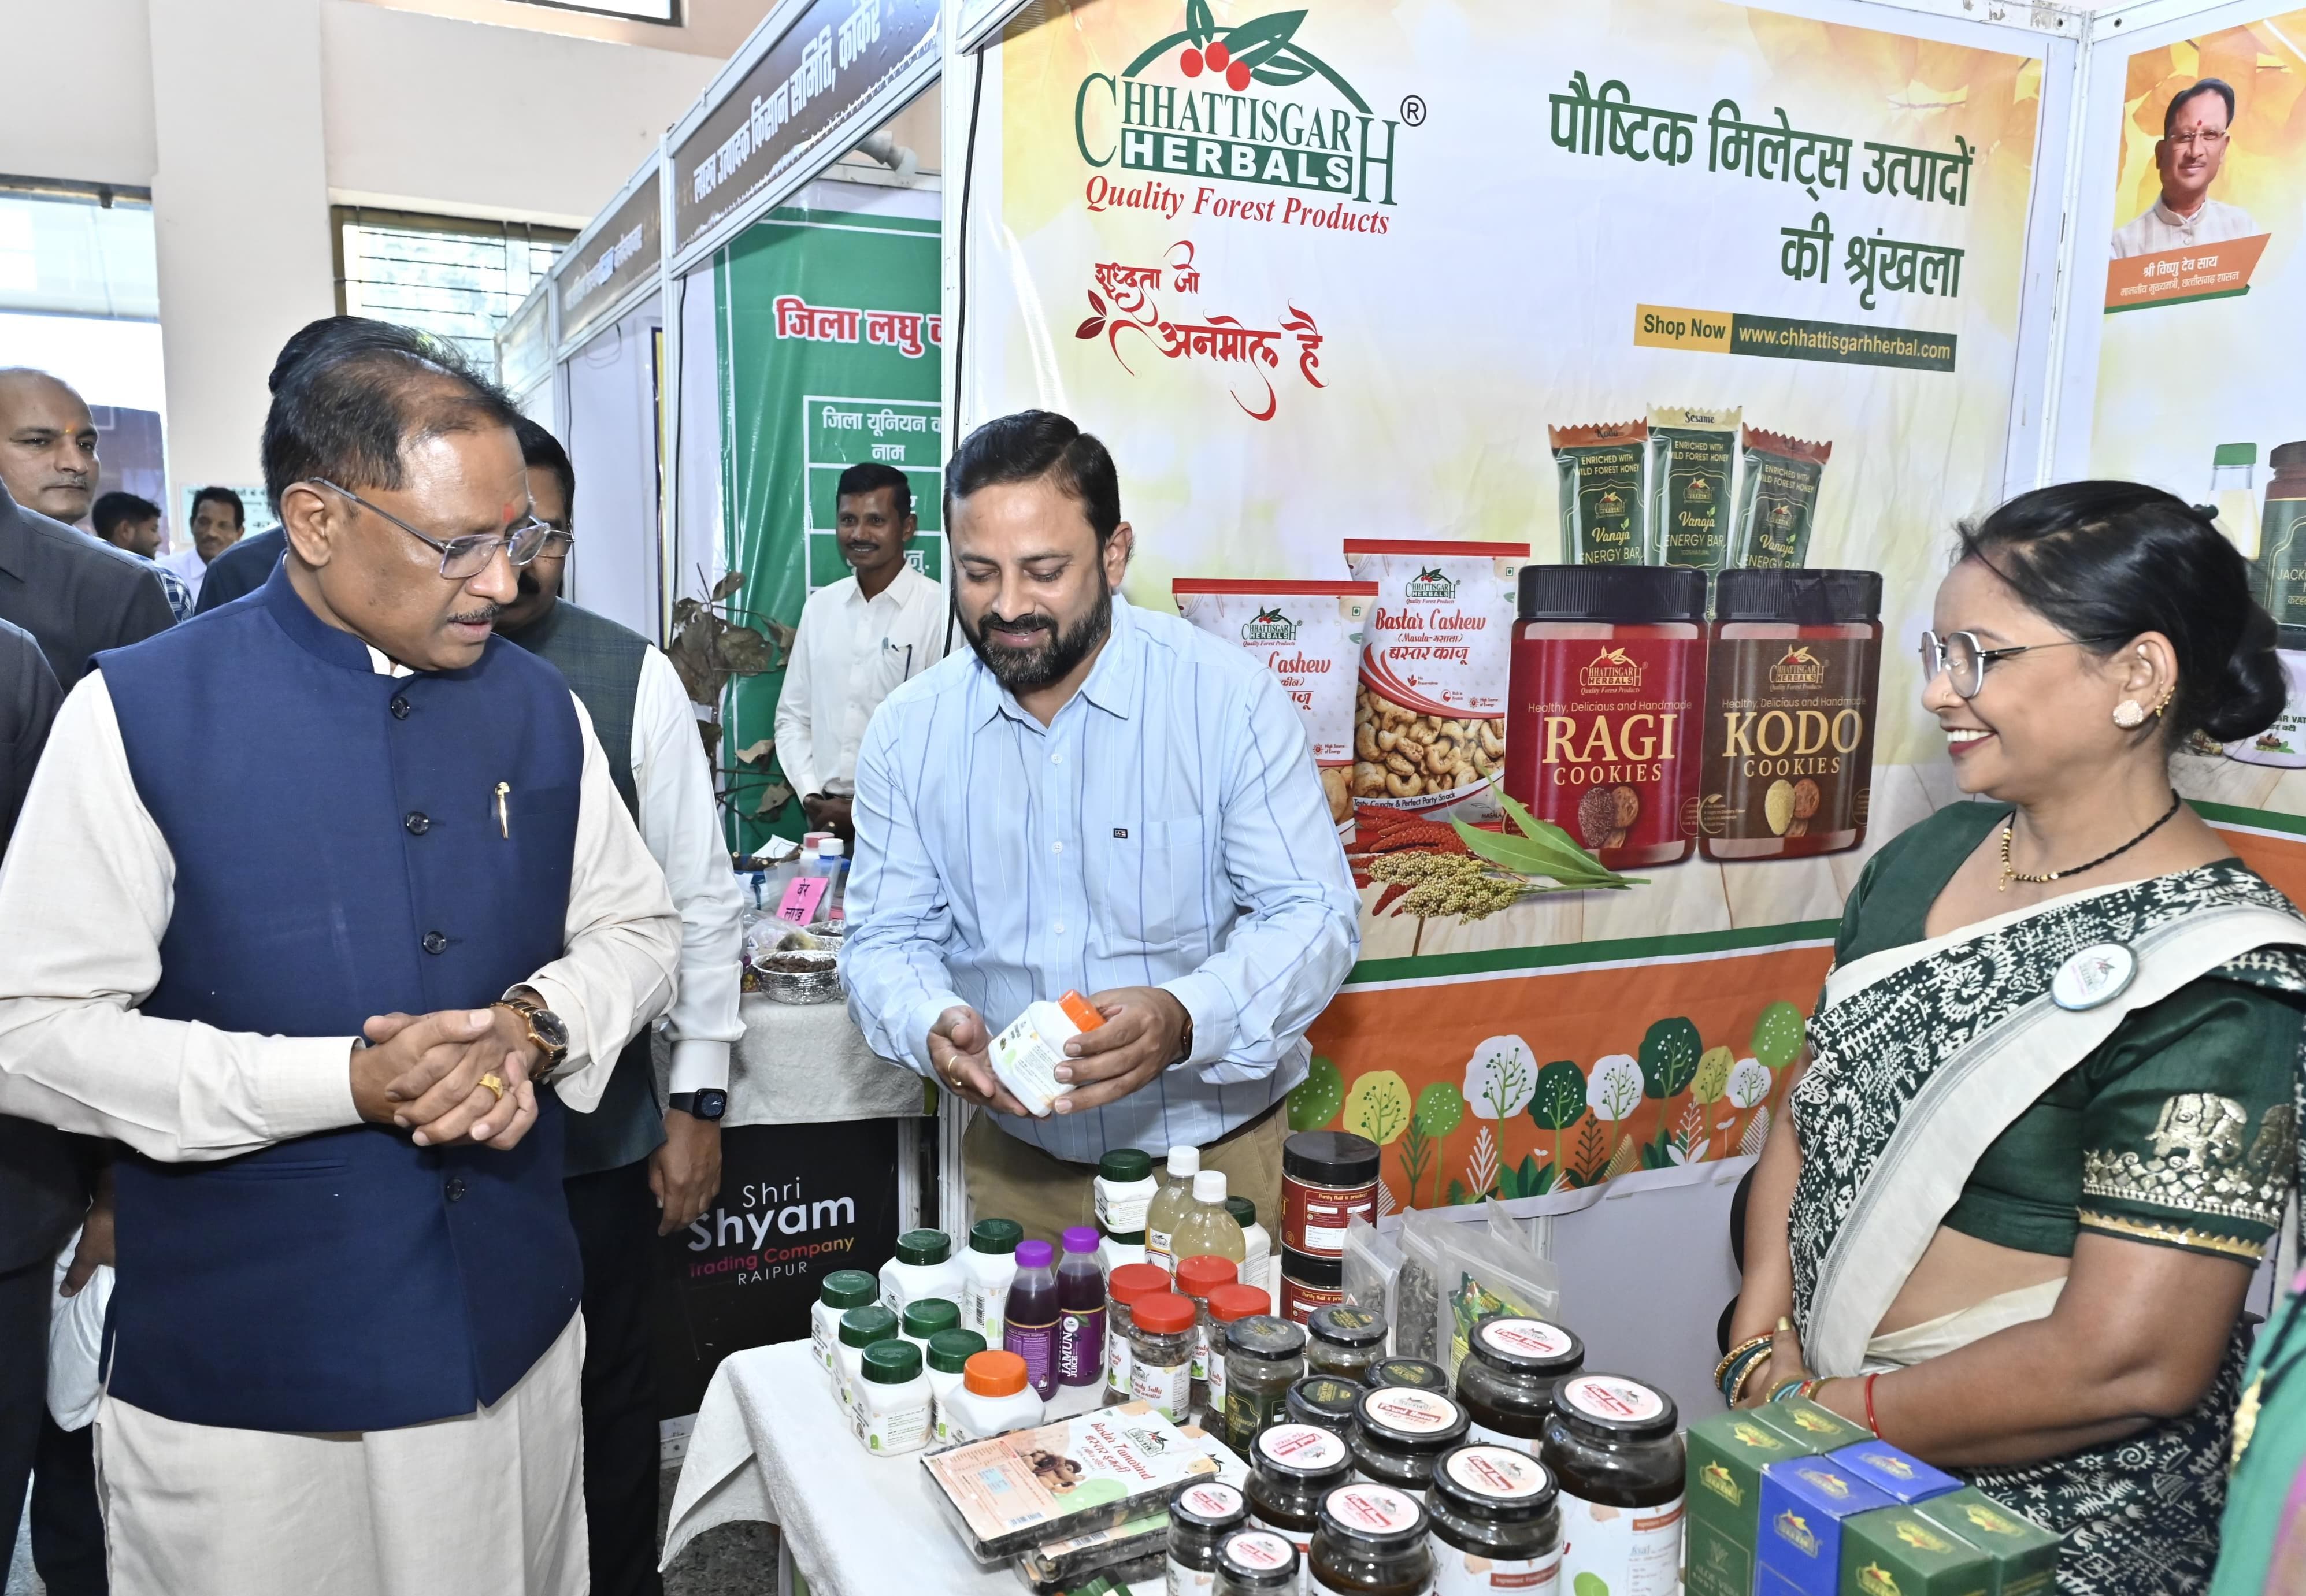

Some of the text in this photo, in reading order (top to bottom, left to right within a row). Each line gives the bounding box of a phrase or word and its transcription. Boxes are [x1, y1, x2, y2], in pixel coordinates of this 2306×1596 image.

[693, 153, 717, 203] लाख
[751, 95, 789, 154] किसान
[1074, 72, 1400, 206] CHHATTISGARH
[1549, 70, 1975, 206] पौष्टिक मिलेट्स उत्पादों
[1125, 131, 1350, 189] HERBALS
[1085, 175, 1389, 235] Quality Forest Products
[1781, 212, 1833, 283] की
[1163, 240, 1200, 294] जो
[2142, 256, 2219, 277] श्री विष्णु देव साय
[2217, 271, 2240, 282] शासन
[774, 296, 861, 342] जिला
[867, 312, 924, 356] लघु
[1644, 314, 1726, 341] Shop Now
[1278, 298, 1330, 388] है
[1739, 326, 1951, 360] www.chhattisgarhherbal.com
[822, 406, 862, 430] जिला
[866, 409, 926, 436] यूनियन
[1685, 411, 1715, 424] Sesame
[872, 443, 905, 461] नाम
[1675, 441, 1708, 450] ENRICHED
[1581, 454, 1633, 465] ENRICHED WITH
[1685, 452, 1708, 461] FOREST
[1710, 454, 1729, 462] HONEY
[1595, 466, 1618, 474] FOREST
[1620, 463, 1640, 473] HONEY
[1765, 464, 1810, 481] ENRICHED WITH
[1774, 477, 1796, 489] FOREST
[1796, 482, 1814, 493] HONEY
[1664, 534, 1723, 547] ENERGY BAR
[1579, 546, 1640, 565] ENERGY BAR
[2277, 569, 2306, 580] JACK
[1406, 582, 1456, 599] CHHATTISGARH
[1376, 608, 1486, 630] Bastar Cashew
[1241, 623, 1297, 641] CHHATTISGARH
[1269, 651, 1331, 673] Cashew
[1389, 646, 1470, 665] बस्तर काजू
[1580, 666, 1641, 686] CHHATTISGARH
[1769, 665, 1824, 684] CHHATTISGARH
[1581, 687, 1599, 695] Quality
[1528, 700, 1692, 715] Healthy, Delicious and Handmade
[1722, 696, 1866, 710] Healthy, Delicious and Handmade
[1542, 714, 1677, 764] RAGI
[1722, 708, 1863, 758] KODO
[1554, 763, 1663, 785] COOKIES
[1743, 756, 1841, 778] COOKIES
[1402, 799, 1421, 807] Perfect
[1423, 796, 1437, 805] Party
[1439, 790, 1456, 801] Snack
[784, 908, 804, 921] लाख
[742, 1176, 800, 1208] Shri
[688, 1196, 855, 1252] Shyam
[689, 1237, 854, 1278] Trading Company
[737, 1261, 807, 1285] RAIPUR
[1062, 1331, 1072, 1377] JAMUN
[1091, 1423, 1116, 1443] Bastar
[1113, 1443, 1156, 1480] Tamarind
